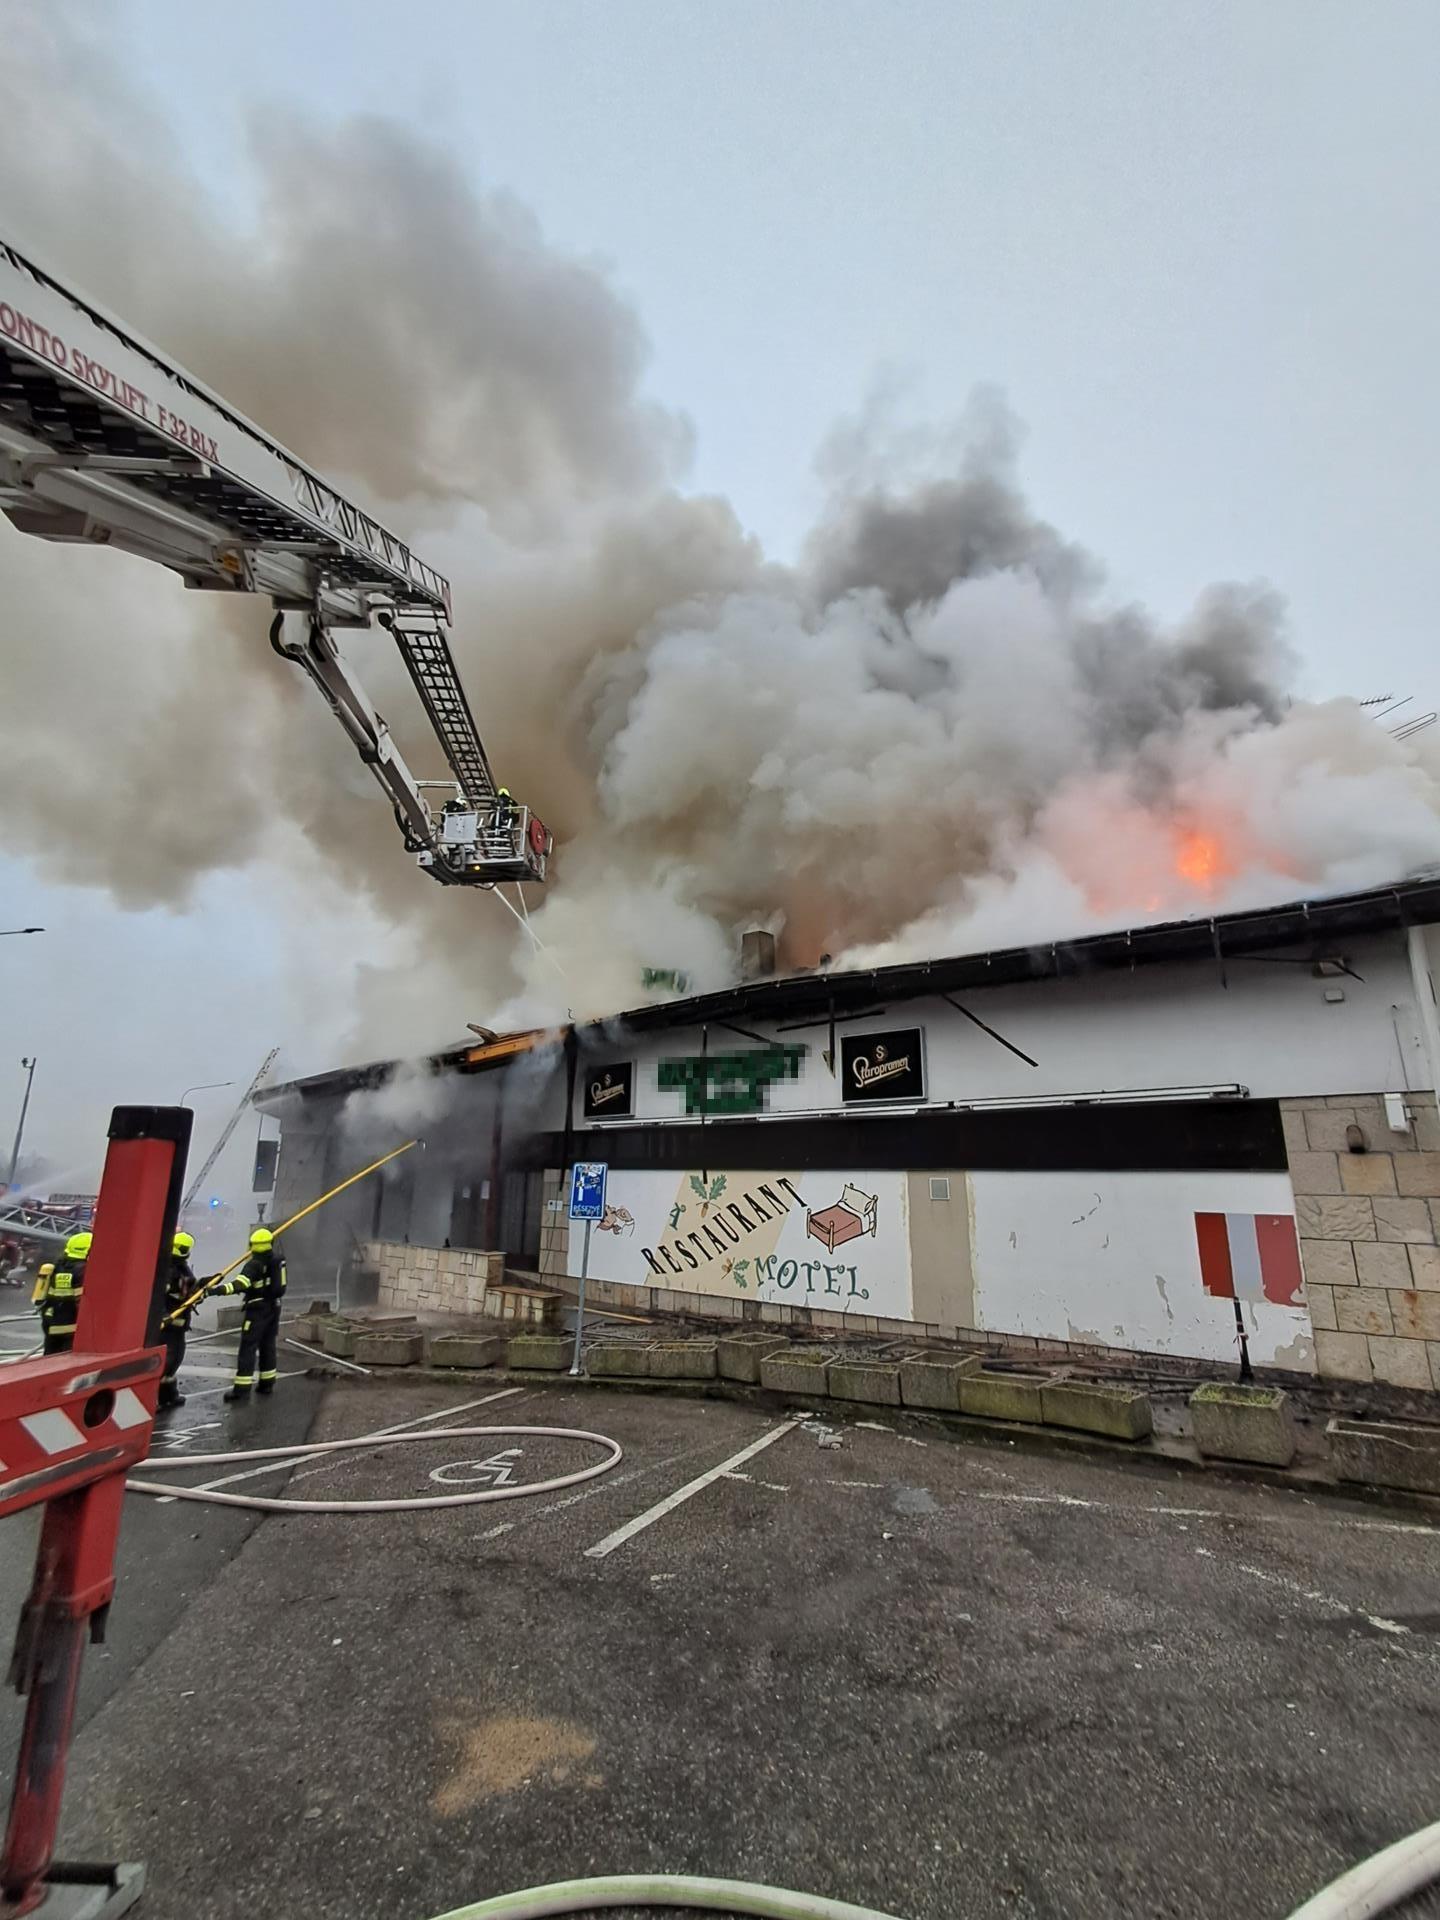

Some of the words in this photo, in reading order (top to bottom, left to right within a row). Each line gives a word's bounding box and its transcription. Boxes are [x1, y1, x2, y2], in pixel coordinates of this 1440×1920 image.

[72, 348, 149, 417] SKYLIFT
[852, 1056, 911, 1088] Staropramen
[641, 1177, 808, 1275] RESTAURANT
[754, 1254, 870, 1300] MOTEL
